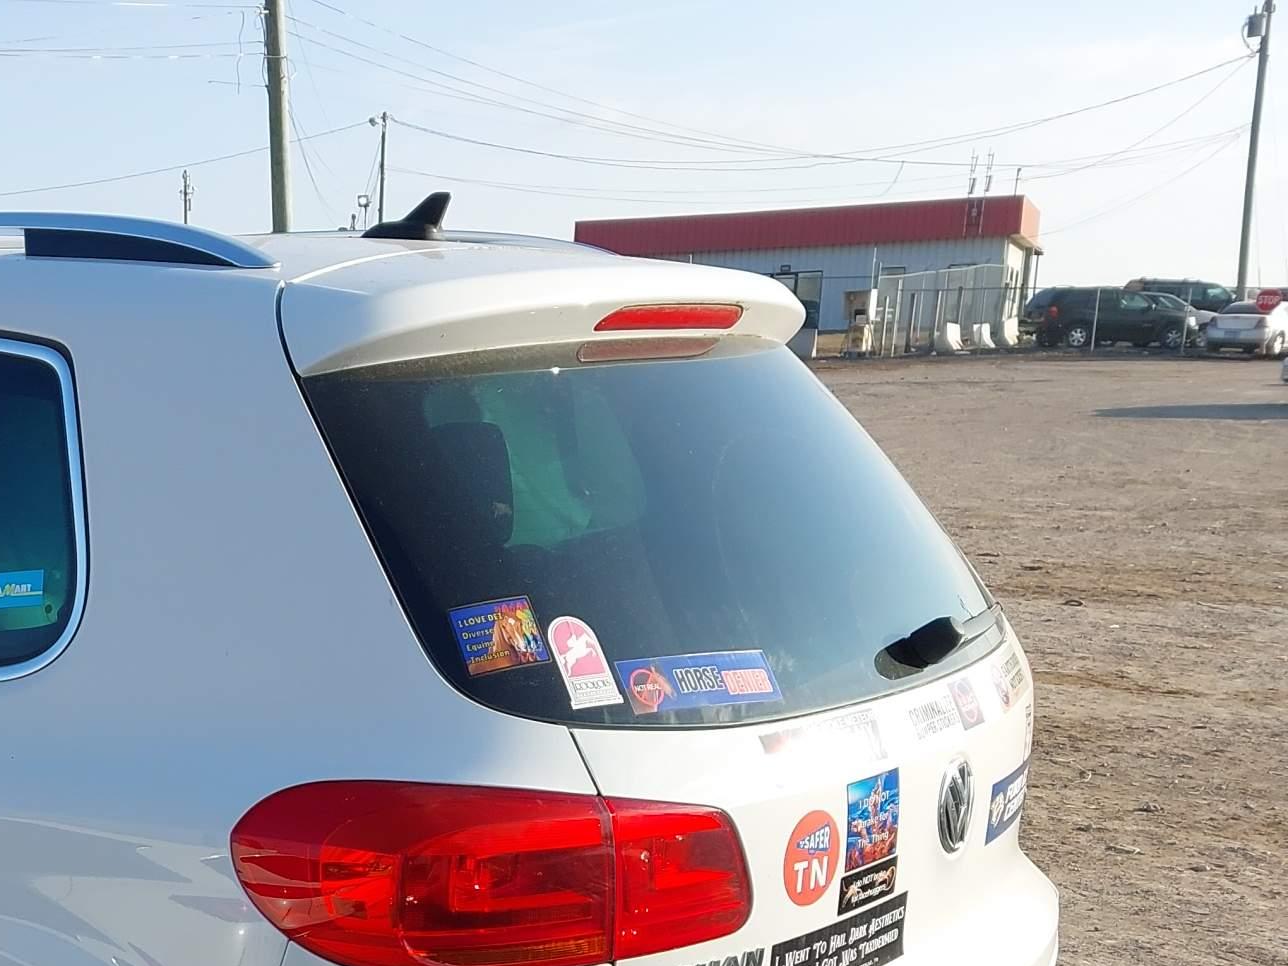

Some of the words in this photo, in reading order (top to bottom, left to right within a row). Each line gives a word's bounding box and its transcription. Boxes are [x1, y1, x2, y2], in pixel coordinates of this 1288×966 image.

[1258, 295, 1280, 305] STOP
[464, 615, 487, 627] LOVE
[471, 650, 510, 664] Inclusion
[673, 666, 725, 694] HORSE
[721, 668, 773, 695] DENIER
[634, 684, 646, 692] NOT
[803, 825, 831, 849] SAFER
[872, 831, 889, 845] Thing
[793, 856, 829, 894] TN
